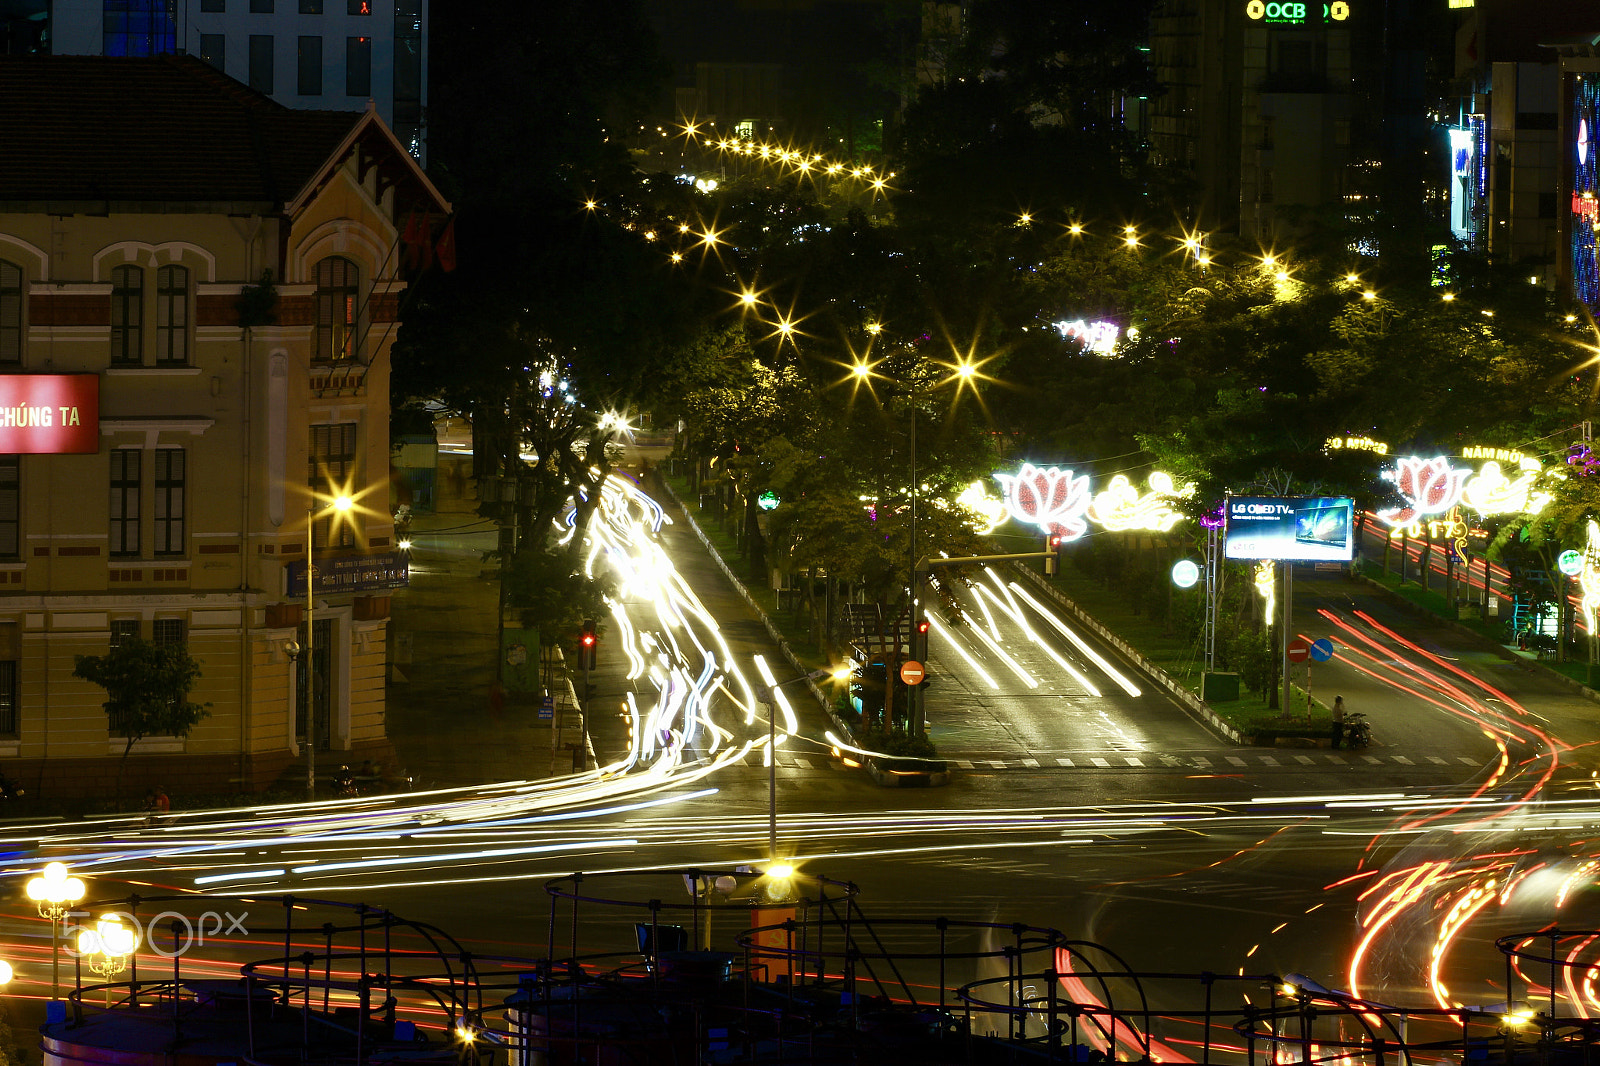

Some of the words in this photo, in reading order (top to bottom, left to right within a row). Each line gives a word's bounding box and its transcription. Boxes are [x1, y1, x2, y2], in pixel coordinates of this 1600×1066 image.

[1266, 2, 1306, 18] OCB
[59, 406, 80, 427] TA
[1463, 444, 1495, 458] NĂM
[1232, 504, 1246, 513] LG
[1275, 505, 1289, 514] TV
[1390, 519, 1455, 538] 2017
[1243, 543, 1255, 551] LG
